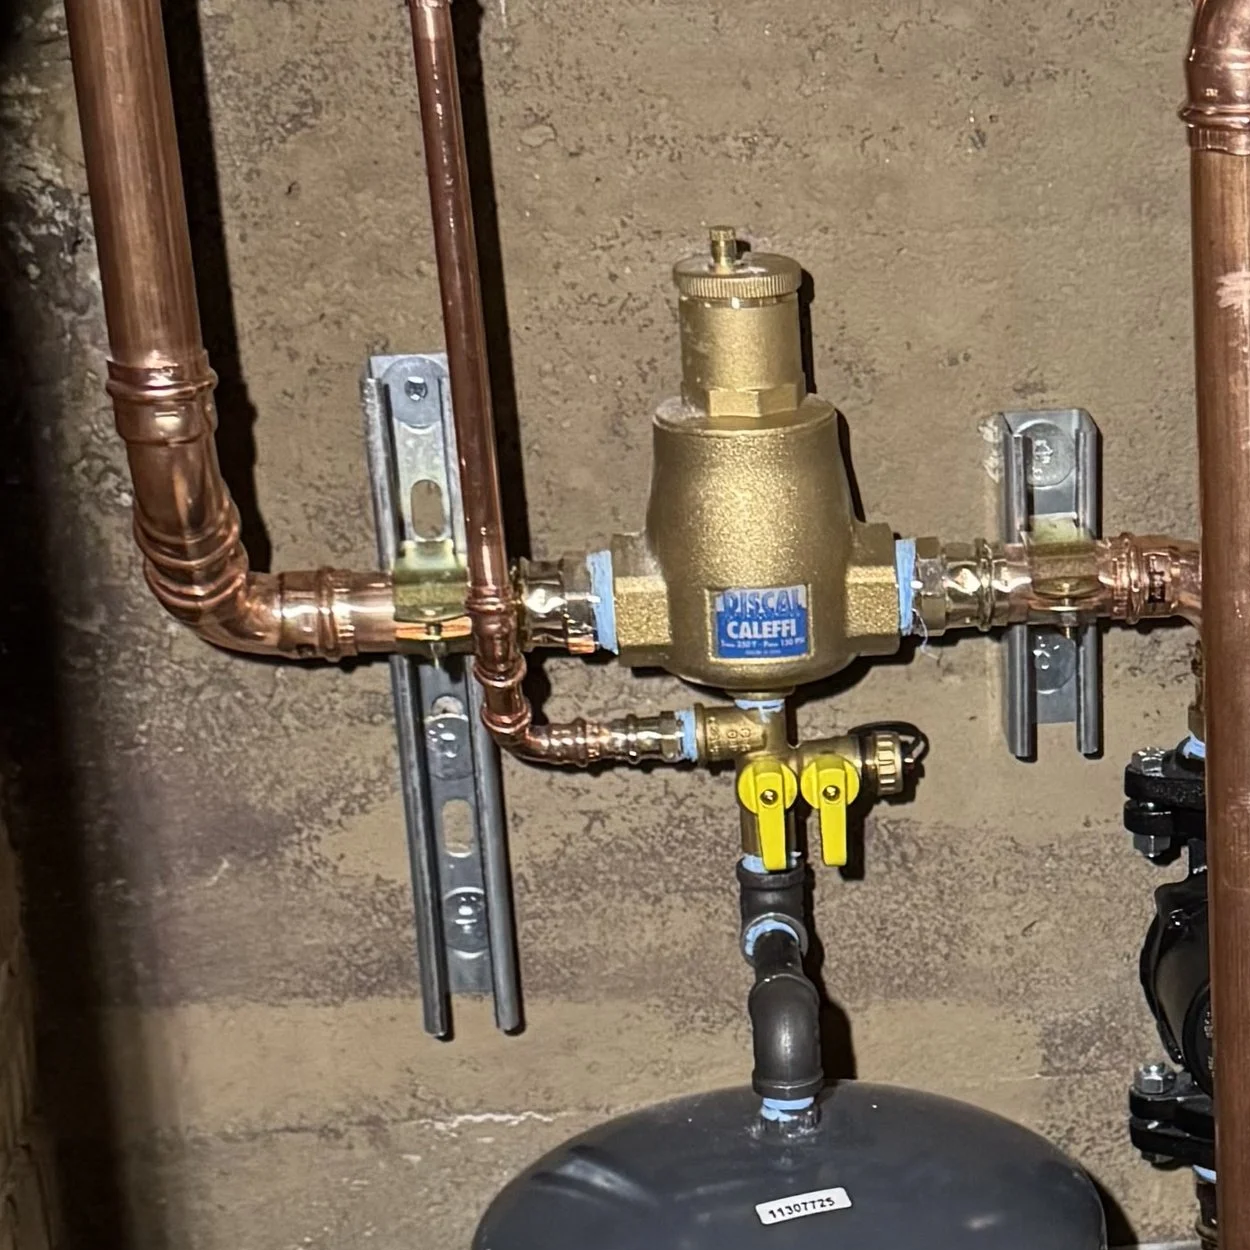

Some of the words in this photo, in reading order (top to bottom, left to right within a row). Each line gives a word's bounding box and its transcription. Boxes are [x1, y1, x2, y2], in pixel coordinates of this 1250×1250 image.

[723, 589, 801, 614] DISCAL
[726, 618, 797, 640] CALEFFI
[768, 1197, 836, 1219] 11307725
